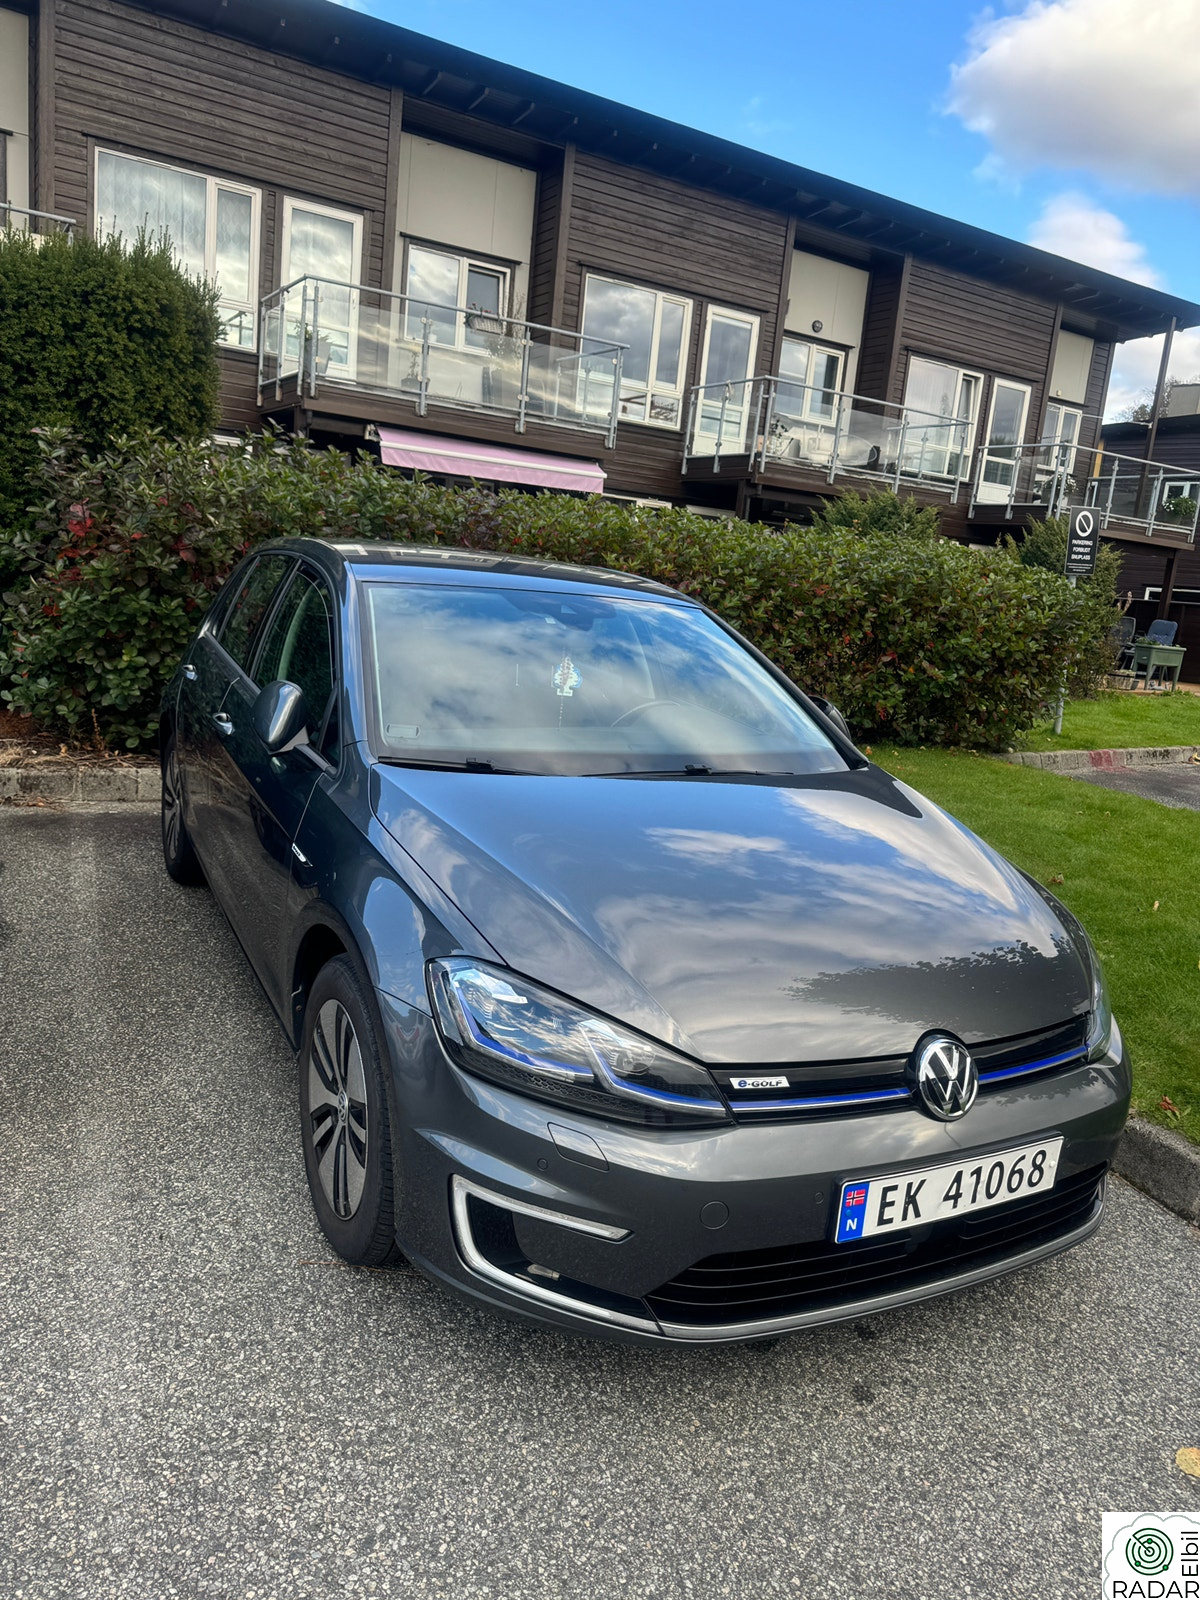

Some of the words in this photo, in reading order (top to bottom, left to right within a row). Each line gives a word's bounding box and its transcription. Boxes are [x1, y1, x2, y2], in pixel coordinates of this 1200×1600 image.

[738, 1080, 783, 1088] e-GOLF
[876, 1178, 927, 1227] EK
[943, 1149, 1047, 1209] 41068
[846, 1217, 858, 1232] N
